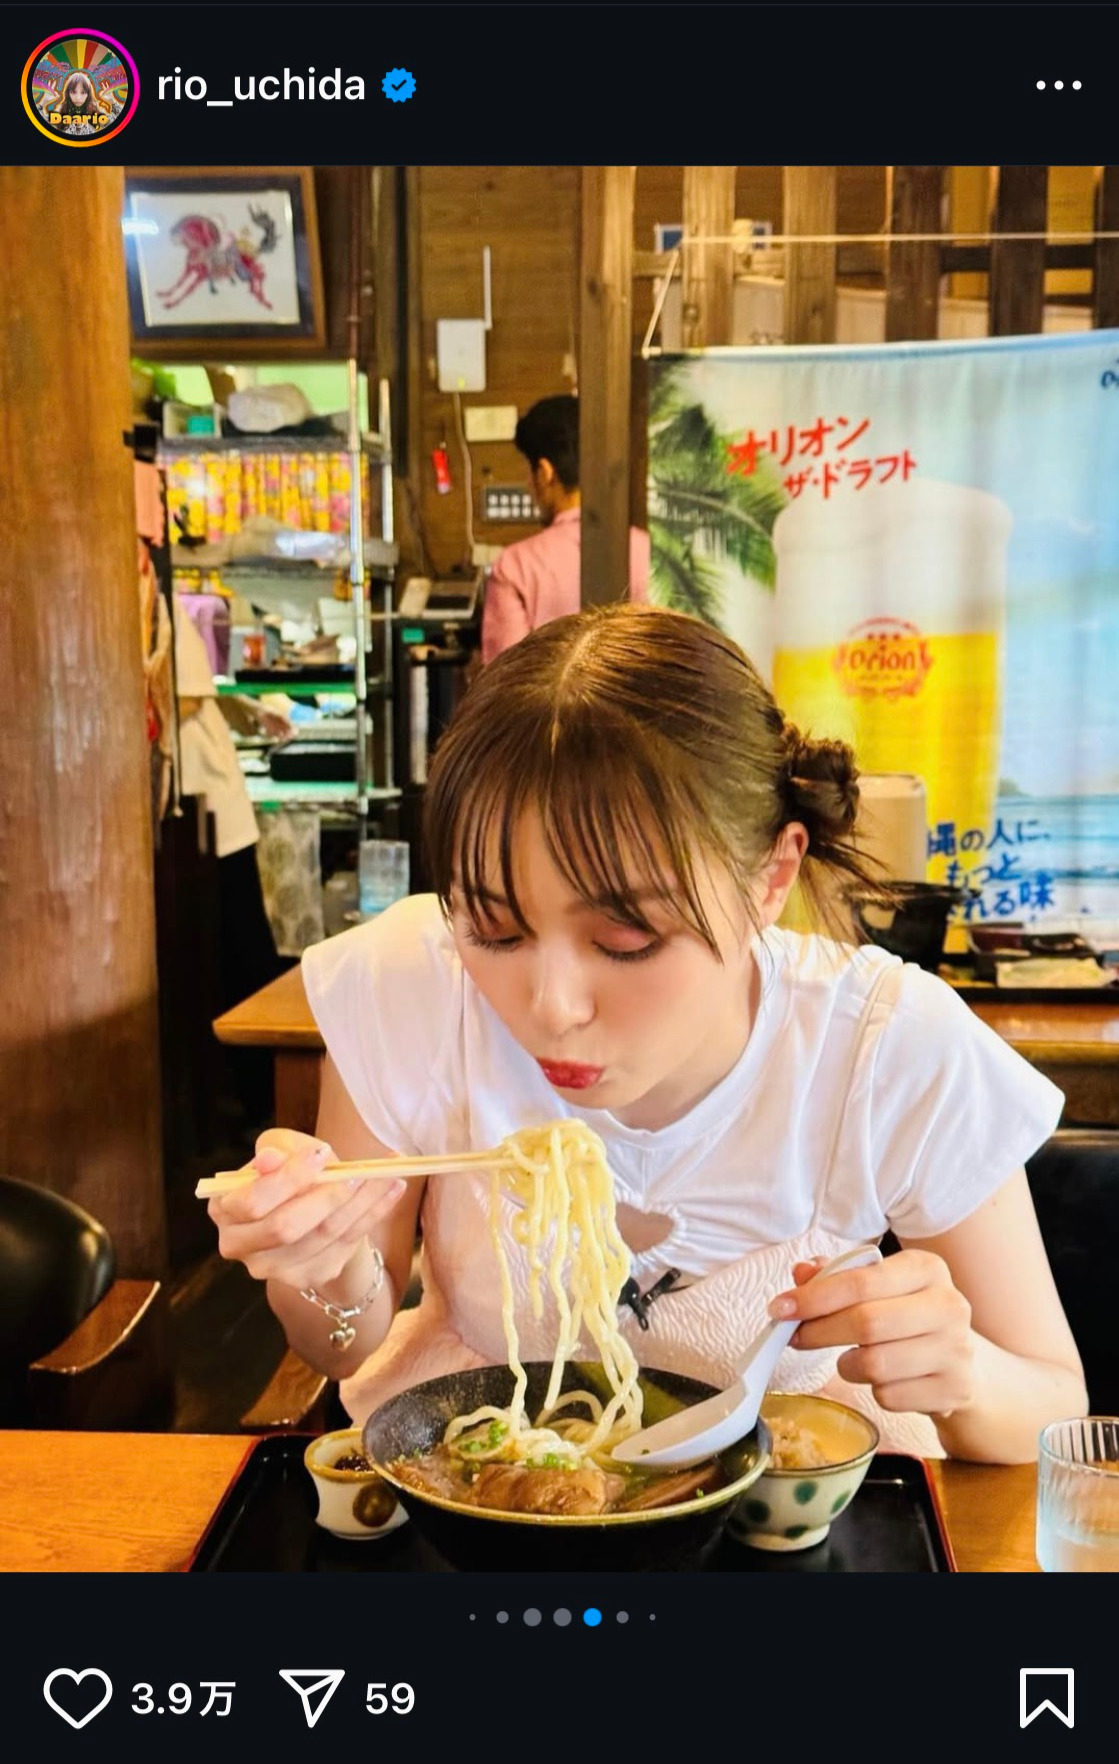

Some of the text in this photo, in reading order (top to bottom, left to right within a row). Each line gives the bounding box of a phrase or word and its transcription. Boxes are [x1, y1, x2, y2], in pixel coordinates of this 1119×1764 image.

[726, 416, 871, 476] オリオン
[783, 449, 917, 500] ザ・ドラフト
[949, 871, 1055, 919] れる味
